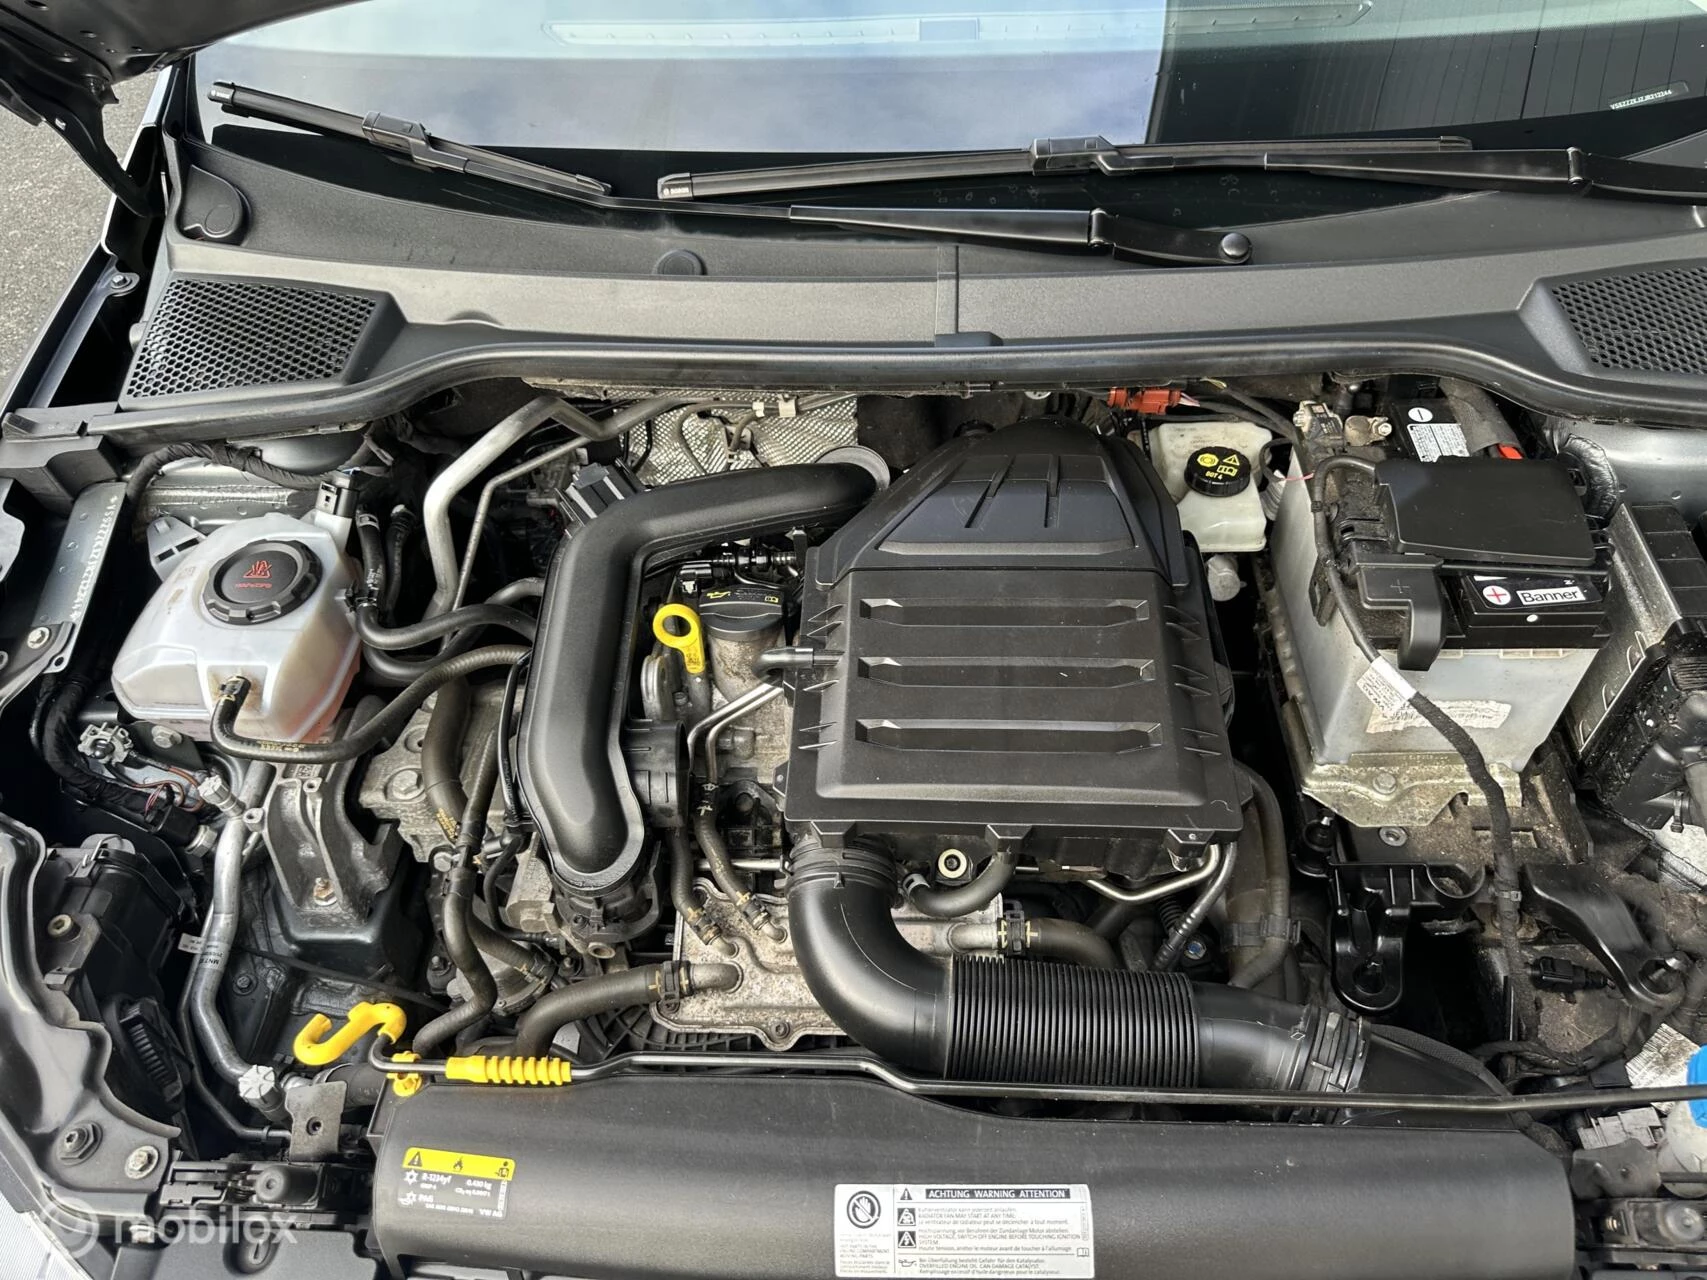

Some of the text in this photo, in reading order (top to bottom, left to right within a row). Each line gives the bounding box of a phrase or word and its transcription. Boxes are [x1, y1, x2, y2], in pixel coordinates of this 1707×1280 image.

[1520, 589, 1579, 603] Banner
[484, 1181, 492, 1190] kg
[928, 1189, 1065, 1198] ACHTUNG WARNING ATTENTION
[479, 1208, 492, 1217] VW
